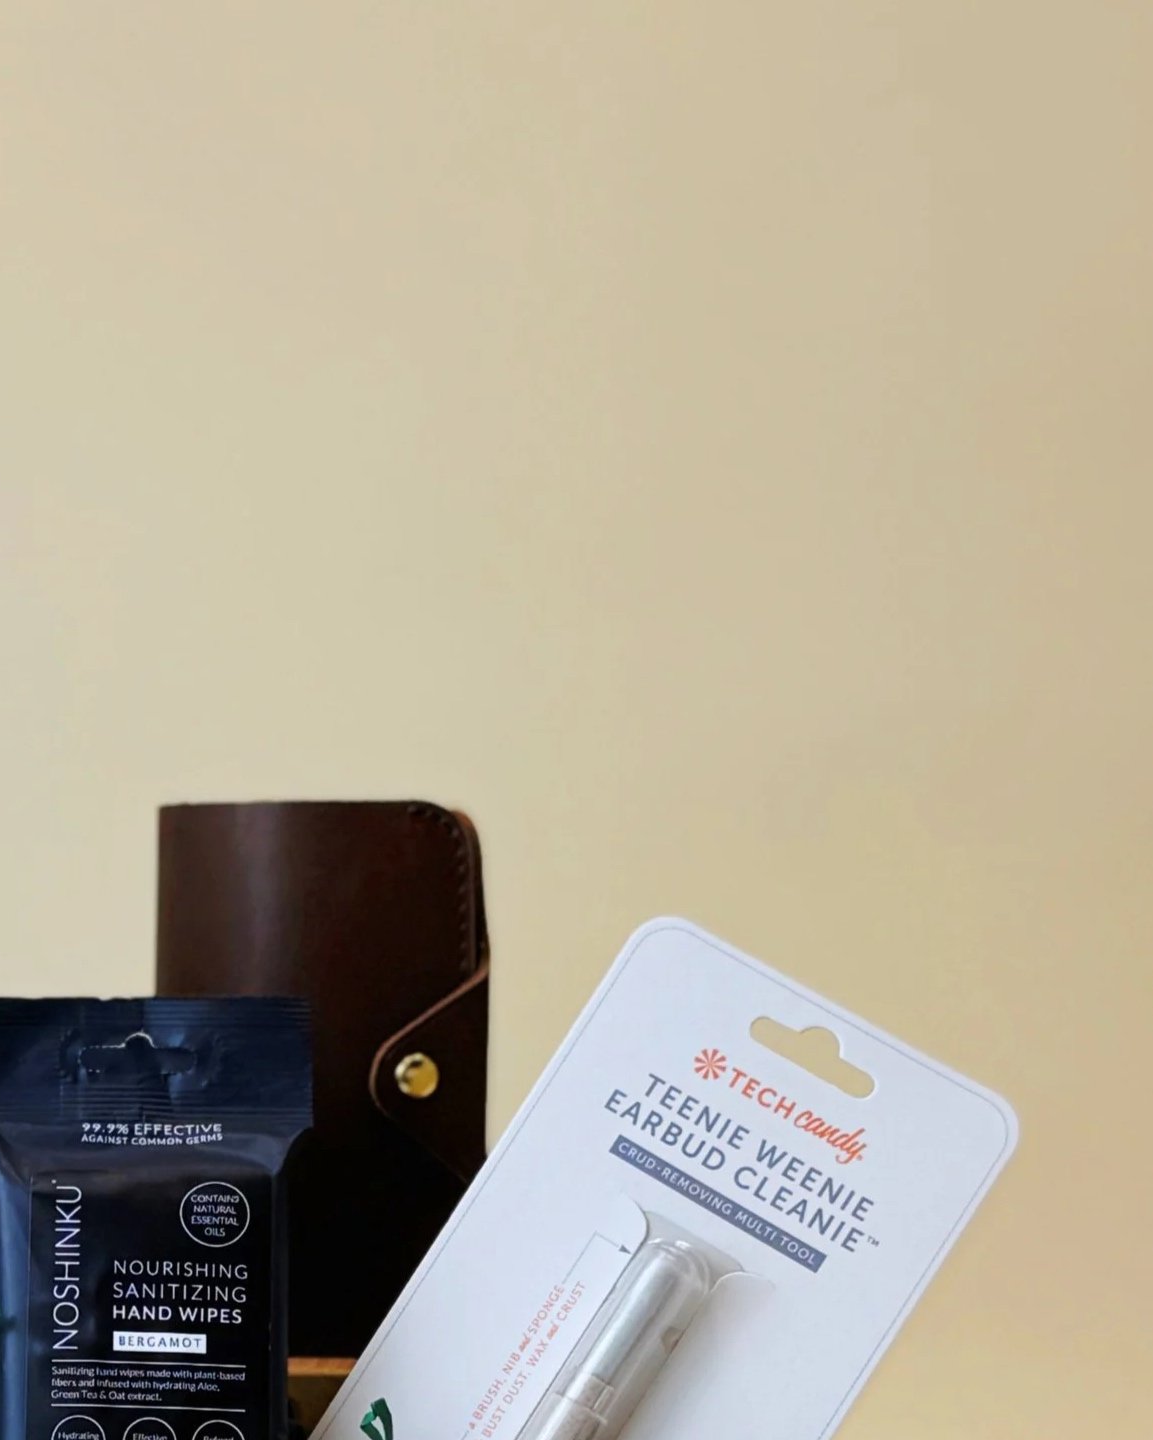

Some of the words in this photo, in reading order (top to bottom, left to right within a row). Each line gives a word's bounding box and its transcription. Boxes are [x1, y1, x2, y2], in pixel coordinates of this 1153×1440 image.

[729, 1067, 797, 1120] TECH
[82, 1122, 129, 1135] 99.9%
[134, 1123, 222, 1136] EFFECTIVE
[604, 1089, 726, 1172] EARBUD
[81, 1134, 128, 1145] AGAINST
[131, 1136, 182, 1146] COMMON
[186, 1133, 223, 1145] GERMS
[644, 1073, 750, 1150] TEENIE
[756, 1140, 875, 1222] WEENIE
[193, 1205, 237, 1214] NATURAL
[617, 1142, 734, 1215] CRUD-REMOVING
[735, 1211, 779, 1242] MULTI
[779, 1236, 818, 1265] TOOL
[191, 1215, 239, 1226] ESSENTIAL
[204, 1227, 226, 1237] OILS
[52, 1184, 83, 1350] NOSHINKU
[113, 1260, 248, 1279] NOURISHING
[113, 1282, 247, 1303] SANITIZING
[113, 1305, 172, 1321] HAND
[179, 1307, 242, 1324] WIPES
[502, 1352, 521, 1375] NIB
[527, 1285, 565, 1335] SPONGE
[119, 1335, 202, 1349] BERGAMOT
[482, 1406, 507, 1438] BUST
[526, 1339, 548, 1367] WAX
[556, 1280, 586, 1321] CRUST
[51, 1366, 95, 1377] Sanitizing
[96, 1367, 118, 1377] hand
[119, 1369, 145, 1378] wipes
[147, 1369, 171, 1378] made
[172, 1370, 193, 1379] with
[194, 1371, 246, 1381] plant-based
[51, 1378, 77, 1387] fibers
[78, 1379, 96, 1387] and
[97, 1379, 130, 1389] infused
[131, 1380, 152, 1389] with
[153, 1381, 196, 1392] hydrating
[51, 1389, 80, 1399] Green
[81, 1390, 98, 1399] Tea
[108, 1390, 126, 1400] Oat
